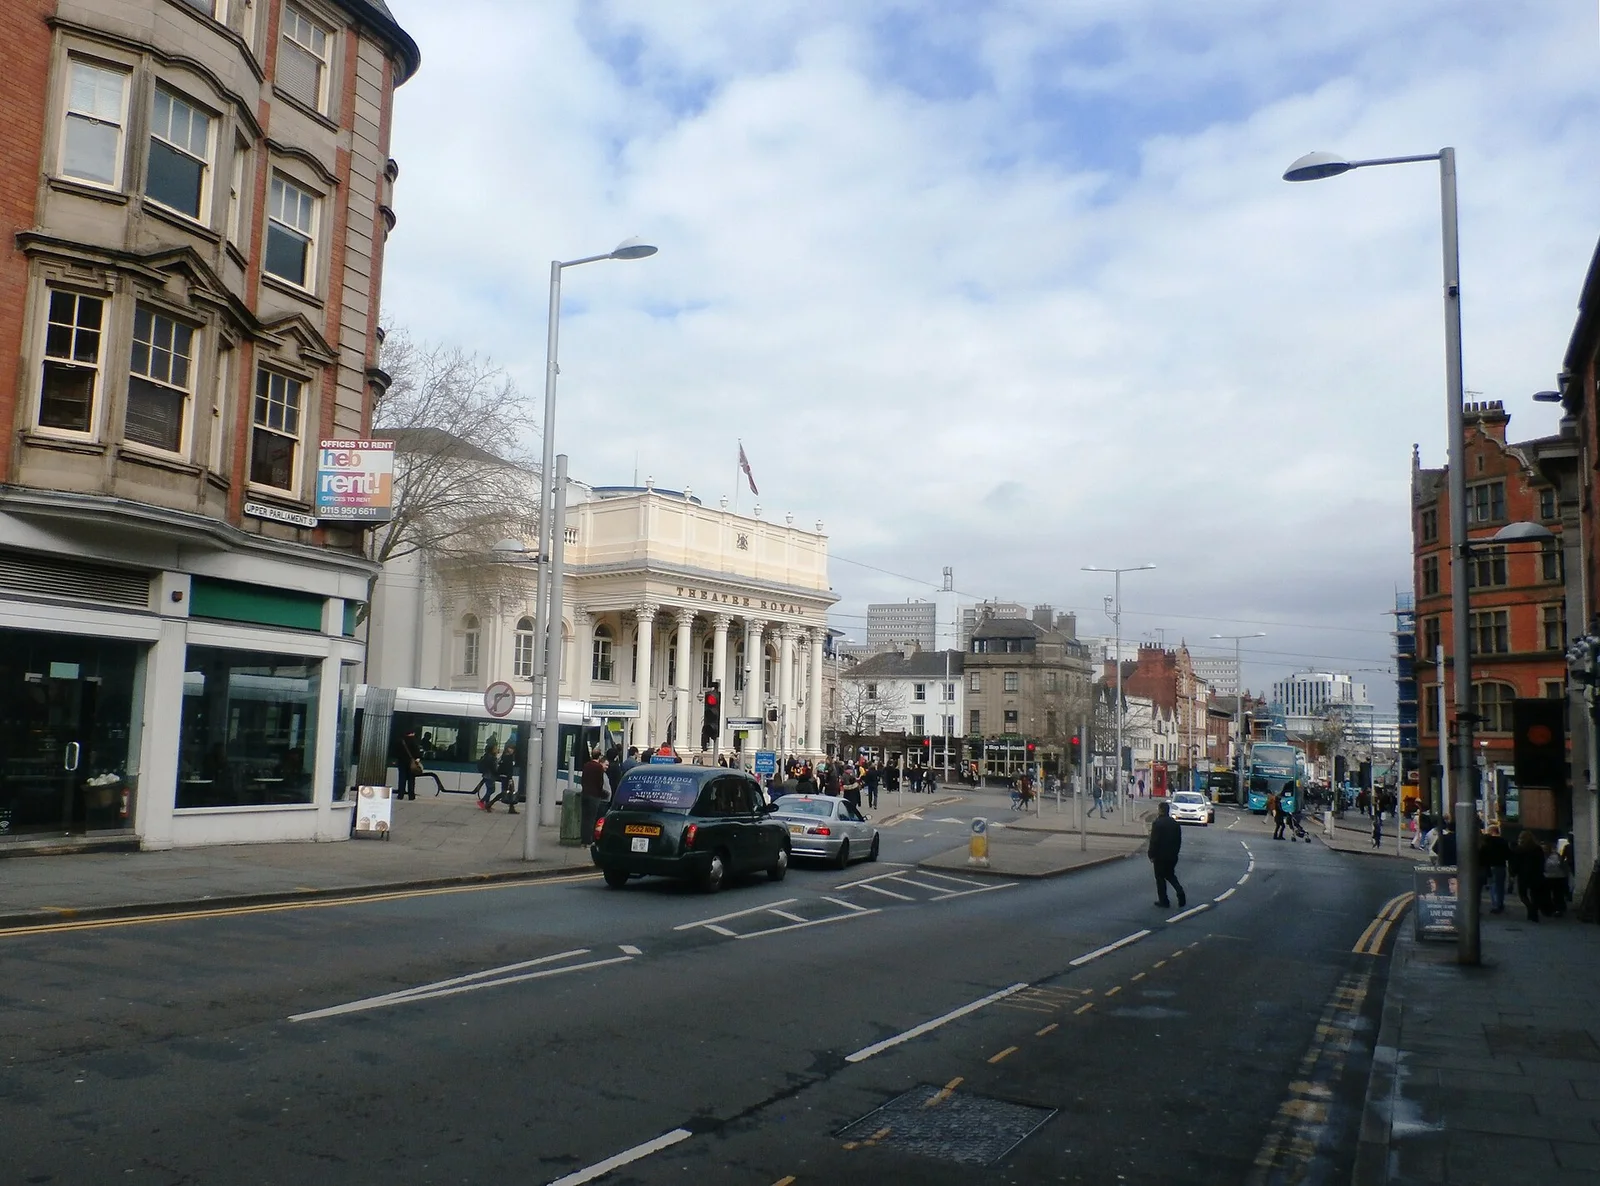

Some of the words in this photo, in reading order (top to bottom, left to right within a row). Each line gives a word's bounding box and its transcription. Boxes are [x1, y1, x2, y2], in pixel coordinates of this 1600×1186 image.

[321, 440, 356, 448] OFFICES
[324, 448, 362, 467] heb
[322, 472, 380, 494] rent!
[246, 504, 267, 516] UPPER
[270, 510, 307, 524] PARLIAMENT
[676, 587, 750, 606] THEATRE
[760, 601, 804, 615] ROYAL
[628, 775, 692, 783] KNIGHTSBRIDGE
